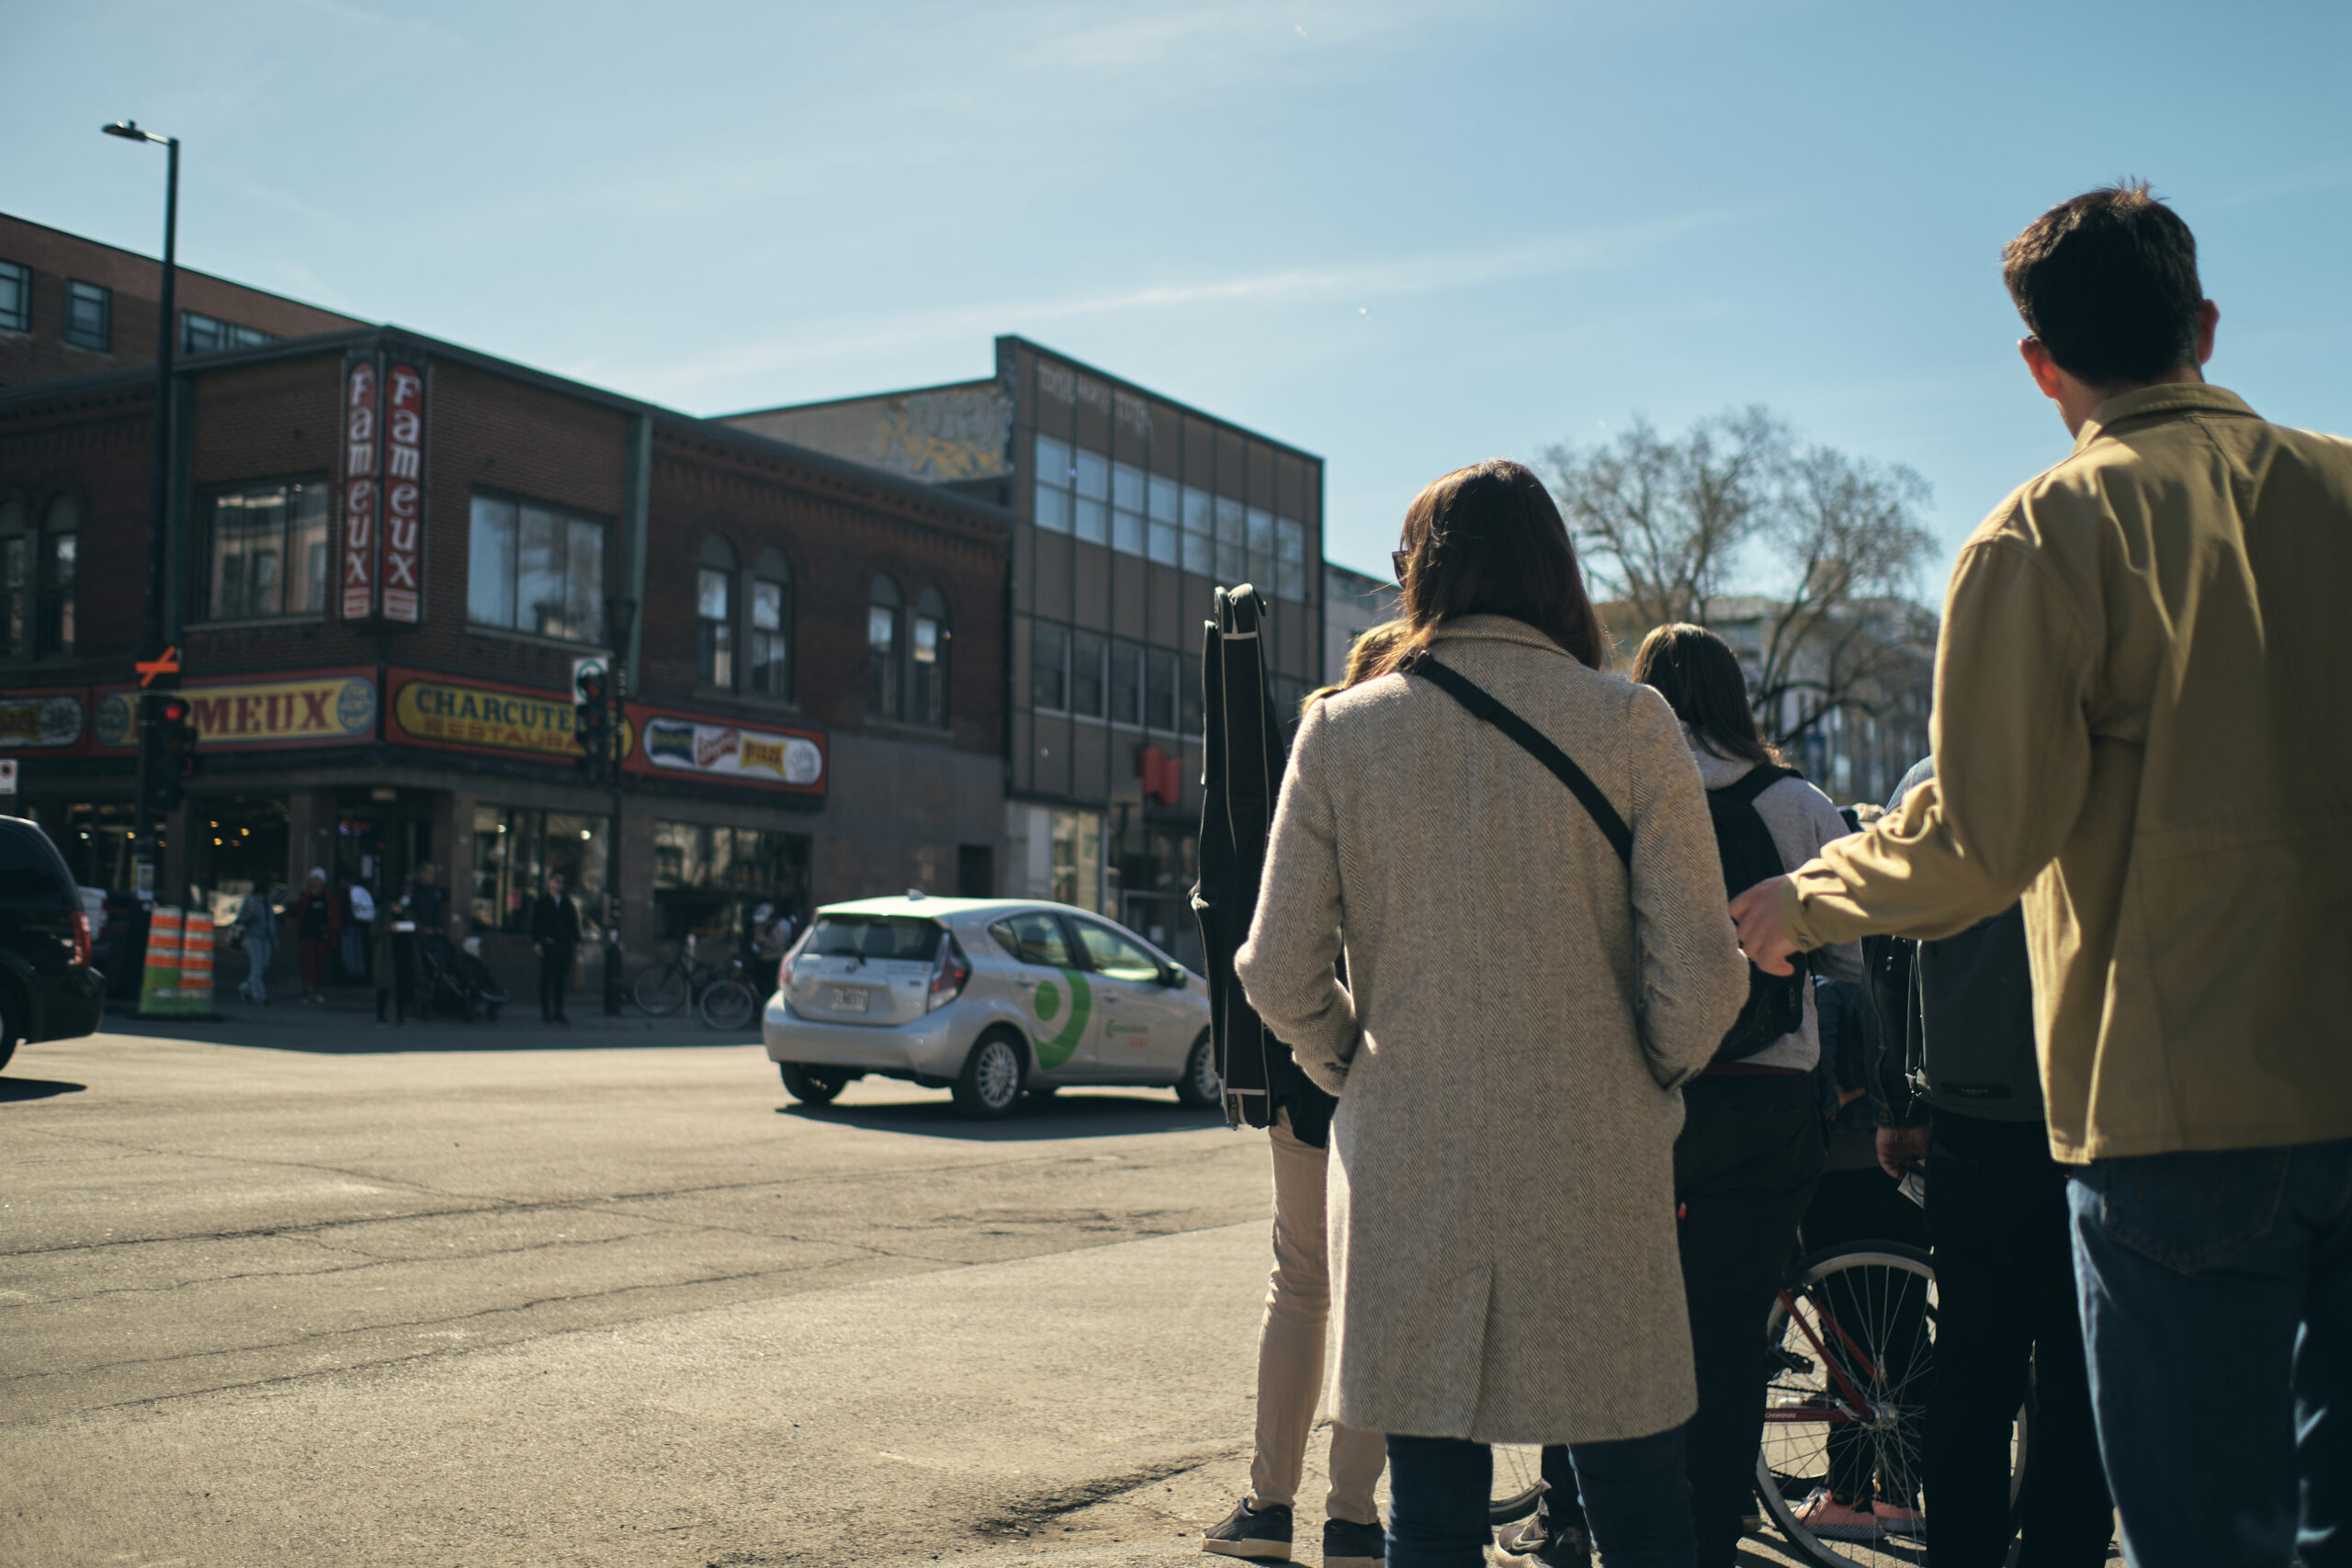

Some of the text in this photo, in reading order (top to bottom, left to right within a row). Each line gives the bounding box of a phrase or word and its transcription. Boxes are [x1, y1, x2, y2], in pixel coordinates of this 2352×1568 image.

[389, 374, 422, 588] Fameux
[133, 688, 334, 739] MEUX
[424, 716, 586, 751] RESTAURA
